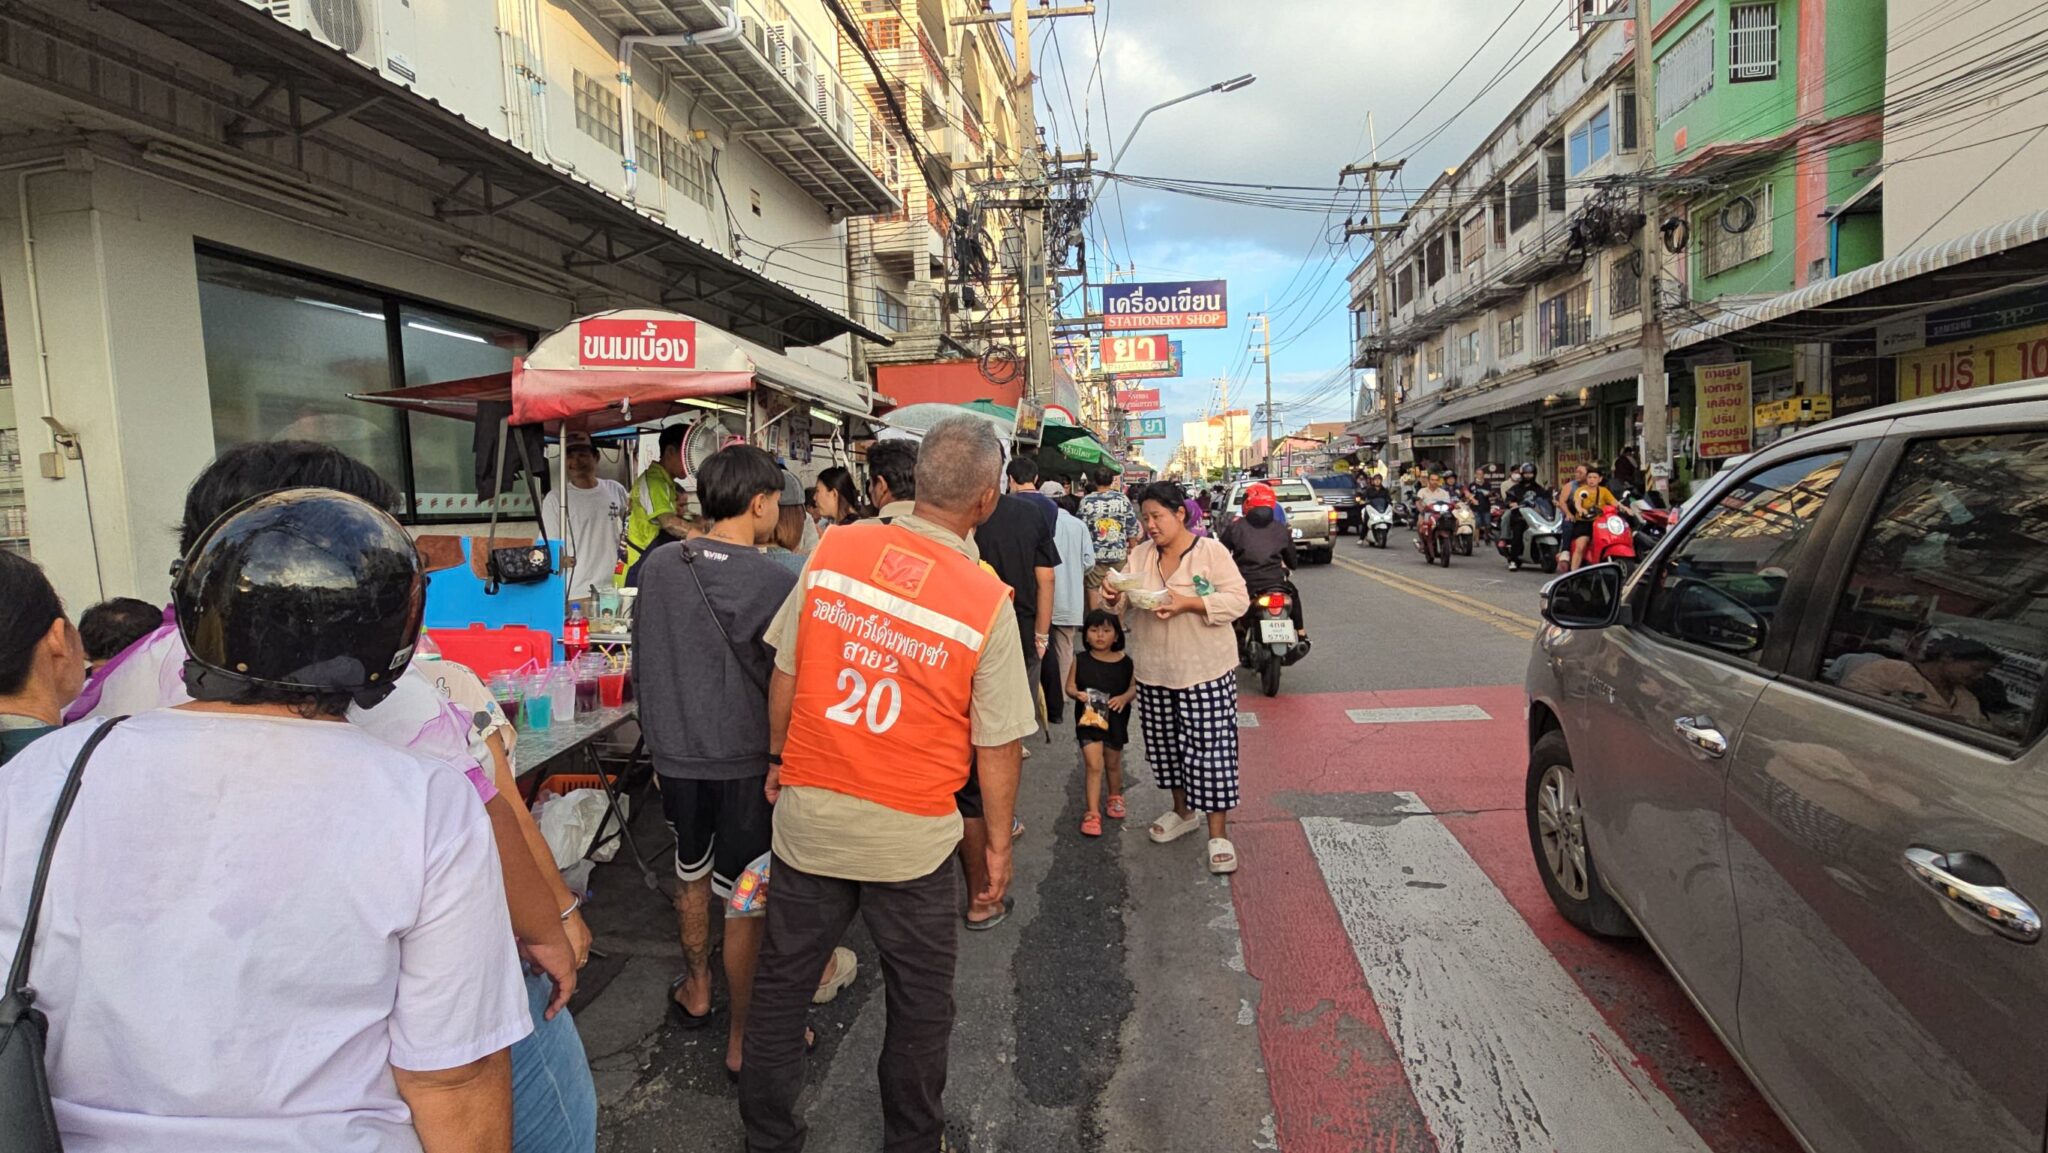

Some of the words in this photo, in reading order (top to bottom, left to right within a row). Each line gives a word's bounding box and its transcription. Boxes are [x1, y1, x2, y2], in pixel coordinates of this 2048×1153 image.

[1108, 286, 1221, 314] เครื่องเขียน
[1108, 316, 1183, 327] STATIONERY
[1186, 314, 1220, 325] SHOP
[1933, 319, 1972, 336] SAMSUNG
[584, 322, 689, 362] ขนมเบื้อง
[1113, 337, 1156, 362] ยา
[1932, 345, 1974, 394] ฟรี
[1704, 382, 1744, 394] เอกสาร
[1144, 420, 1163, 432] ยา
[1702, 425, 1748, 439] กรอบรูป
[825, 667, 902, 734] 20
